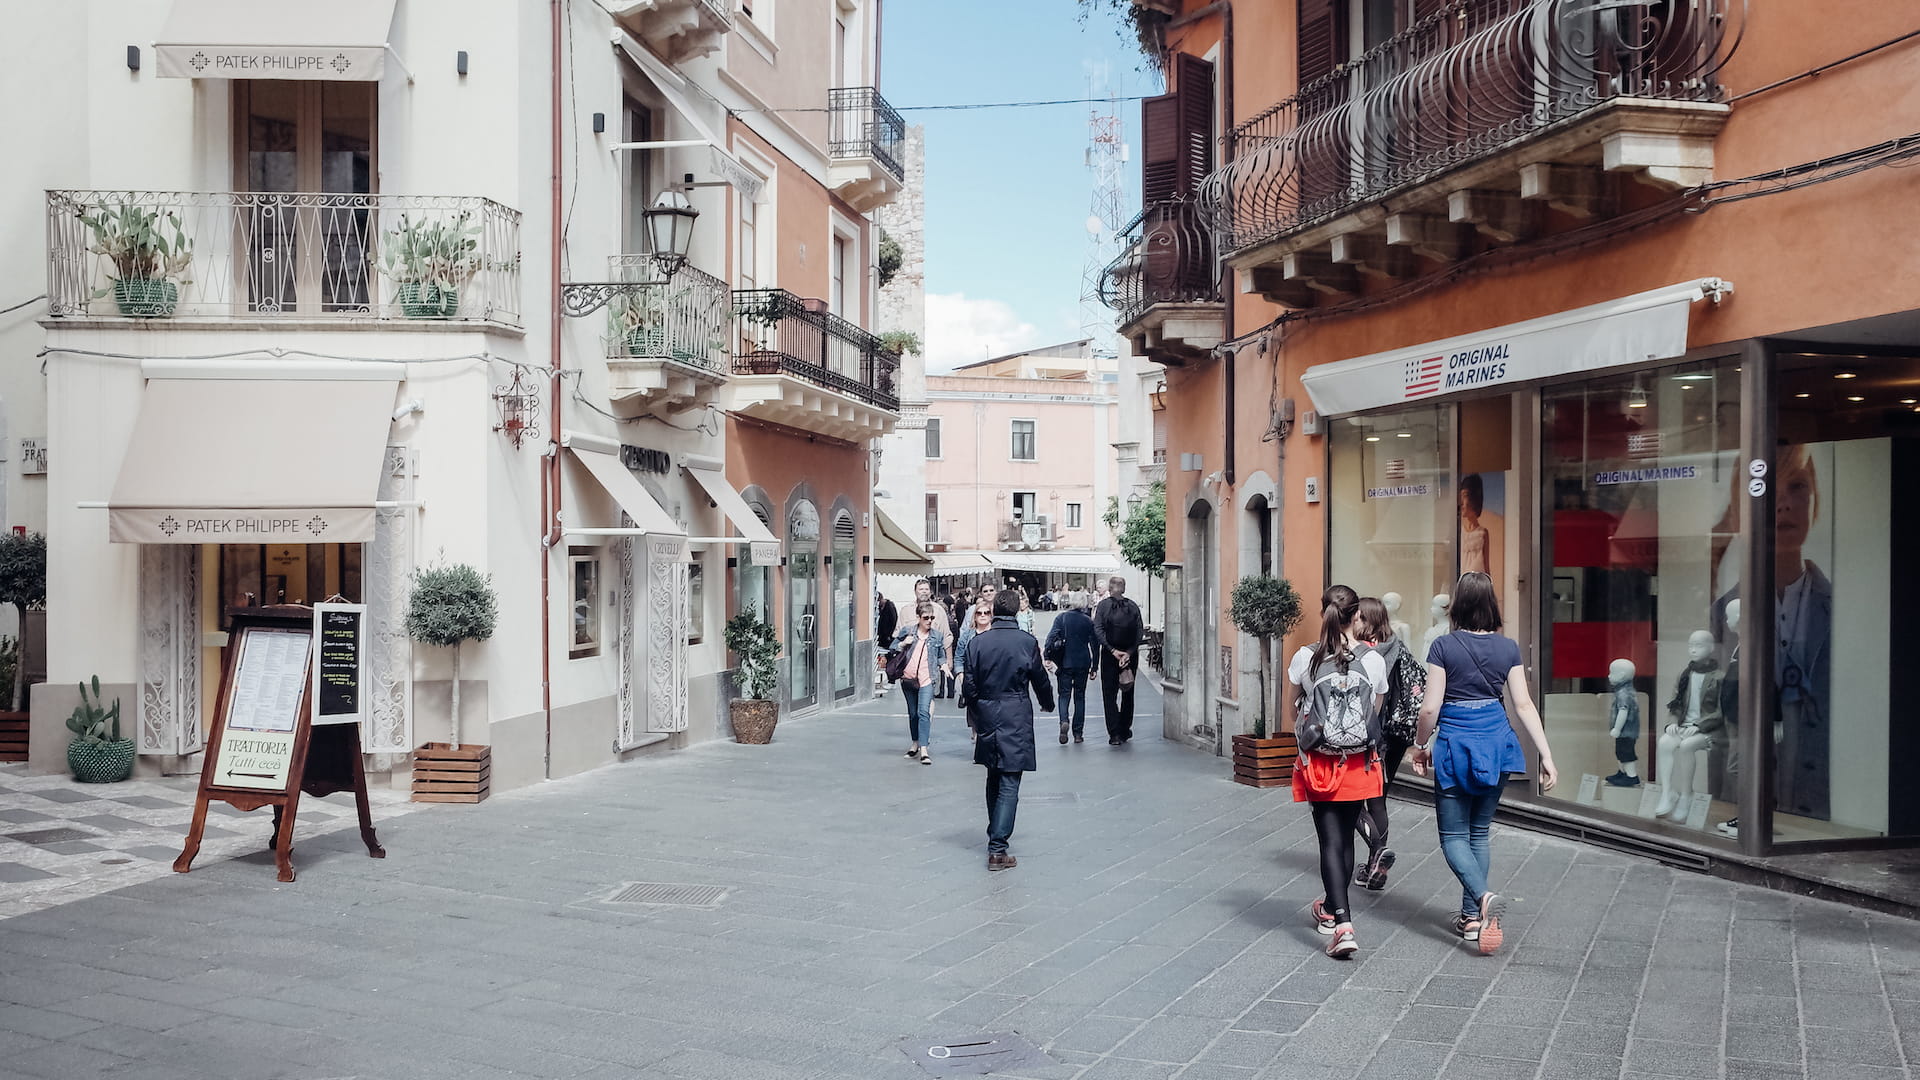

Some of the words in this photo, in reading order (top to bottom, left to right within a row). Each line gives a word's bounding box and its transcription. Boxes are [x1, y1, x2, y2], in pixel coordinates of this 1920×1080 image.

[215, 55, 259, 69] PATEK
[262, 55, 324, 70] PHILIPPE
[1449, 343, 1510, 369] ORIGINAL
[1445, 362, 1506, 389] MARINES
[186, 519, 231, 533] PATEK
[236, 519, 300, 533] PHILIPPE
[227, 739, 287, 755] TRATTORIA
[229, 755, 257, 768] Tutti
